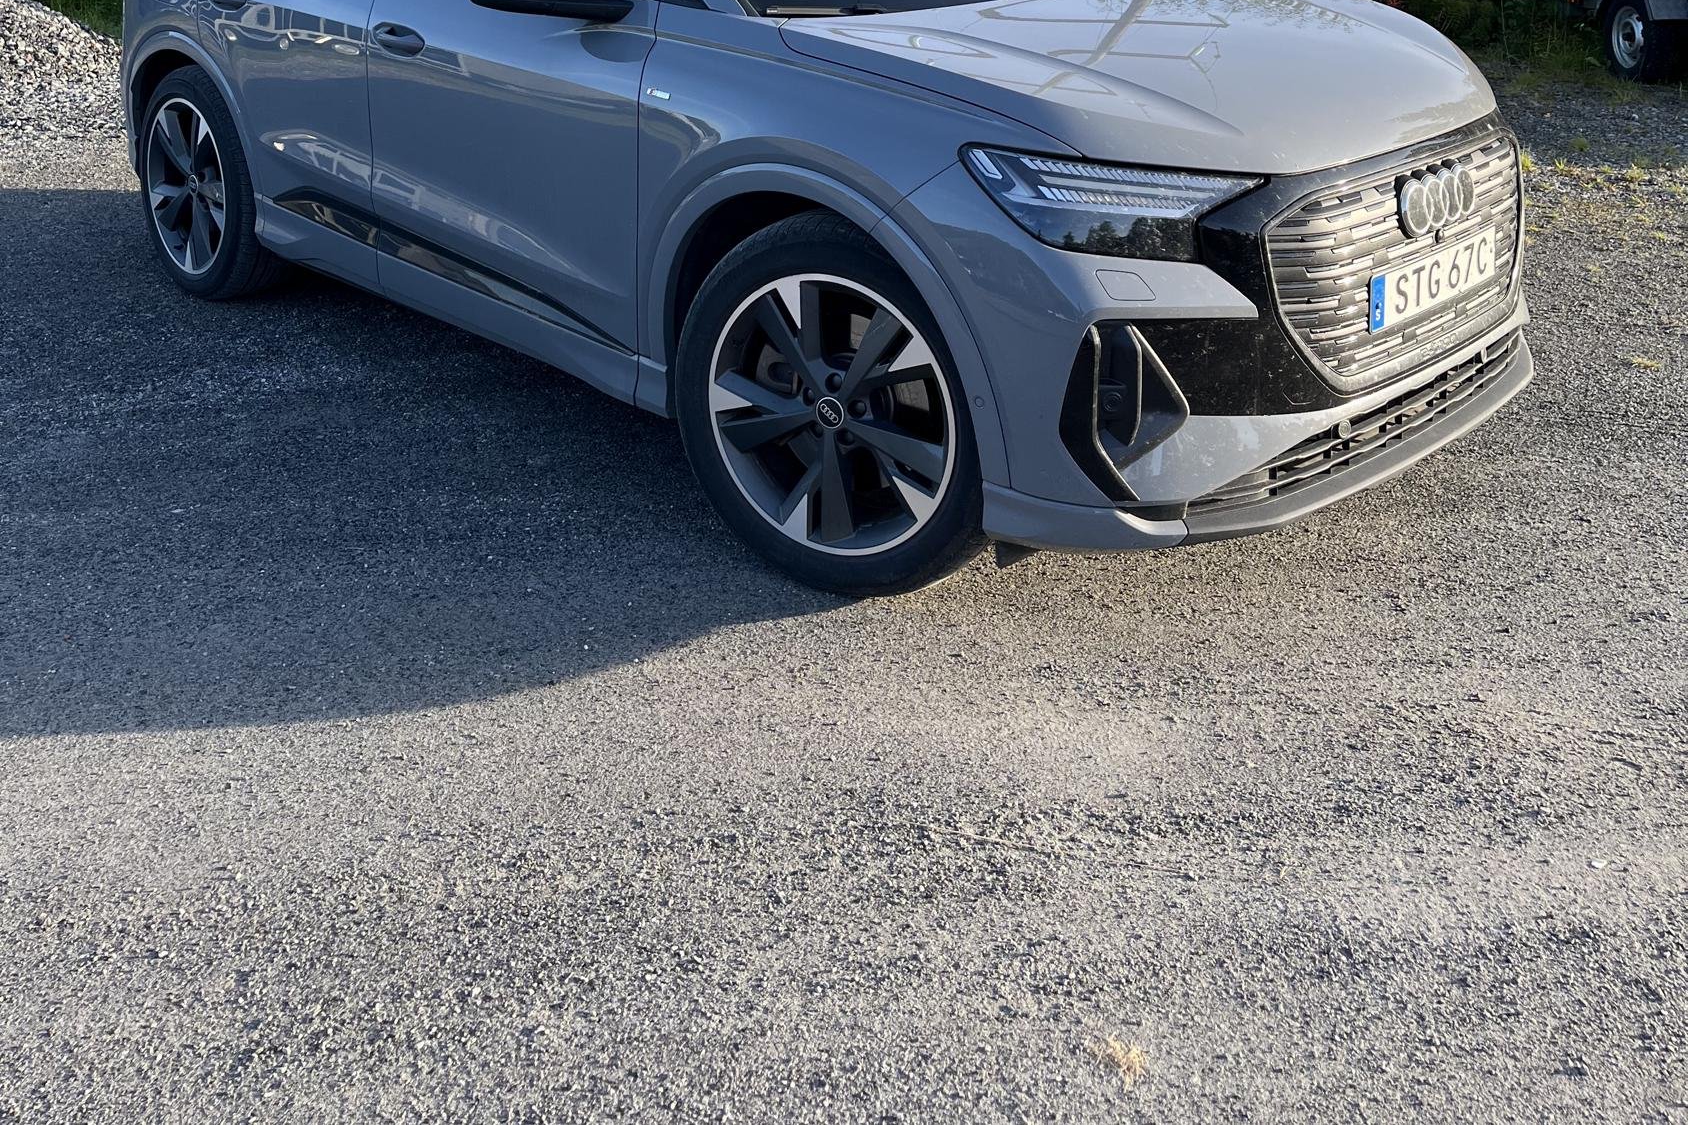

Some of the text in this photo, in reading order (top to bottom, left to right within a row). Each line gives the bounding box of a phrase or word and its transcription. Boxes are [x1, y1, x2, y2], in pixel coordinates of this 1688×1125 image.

[1395, 236, 1488, 314] STG 67C
[1375, 309, 1381, 321] S
